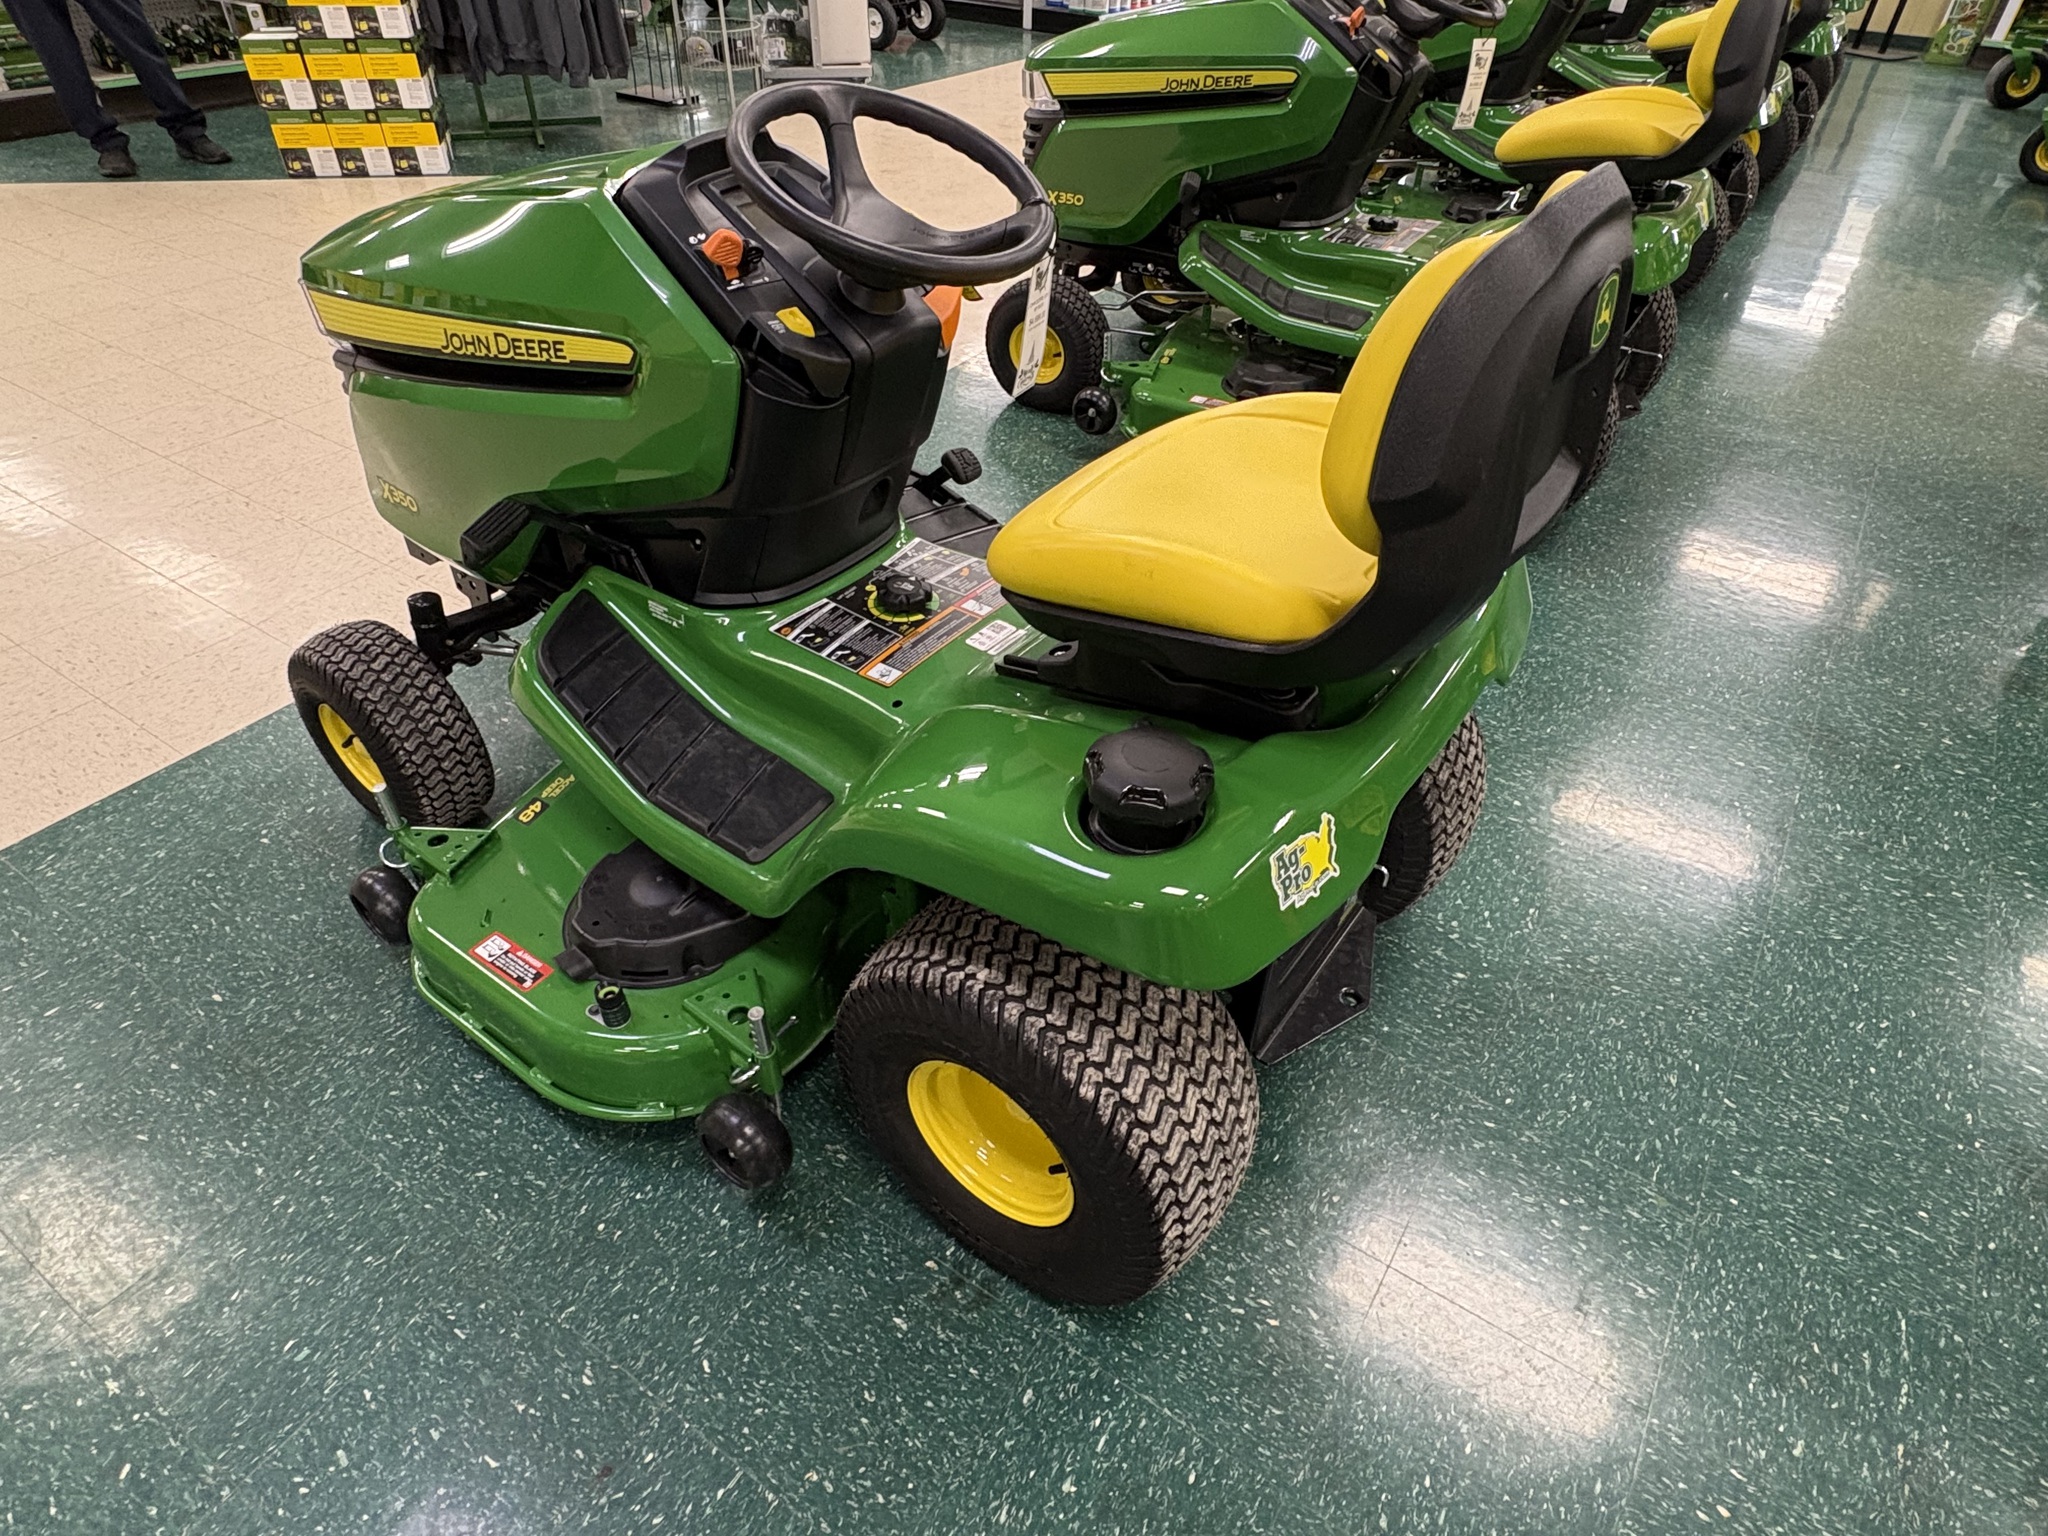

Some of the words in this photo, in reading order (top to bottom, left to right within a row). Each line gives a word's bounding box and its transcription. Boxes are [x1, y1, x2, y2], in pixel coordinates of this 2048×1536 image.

[1160, 77, 1201, 92] JOHN
[1202, 74, 1254, 90] DEERE
[1047, 190, 1084, 206] X350
[440, 328, 492, 355] JOHN
[493, 332, 568, 361] DEERE
[377, 477, 419, 512] X350
[518, 800, 542, 823] 48
[1280, 864, 1312, 902] Pro
